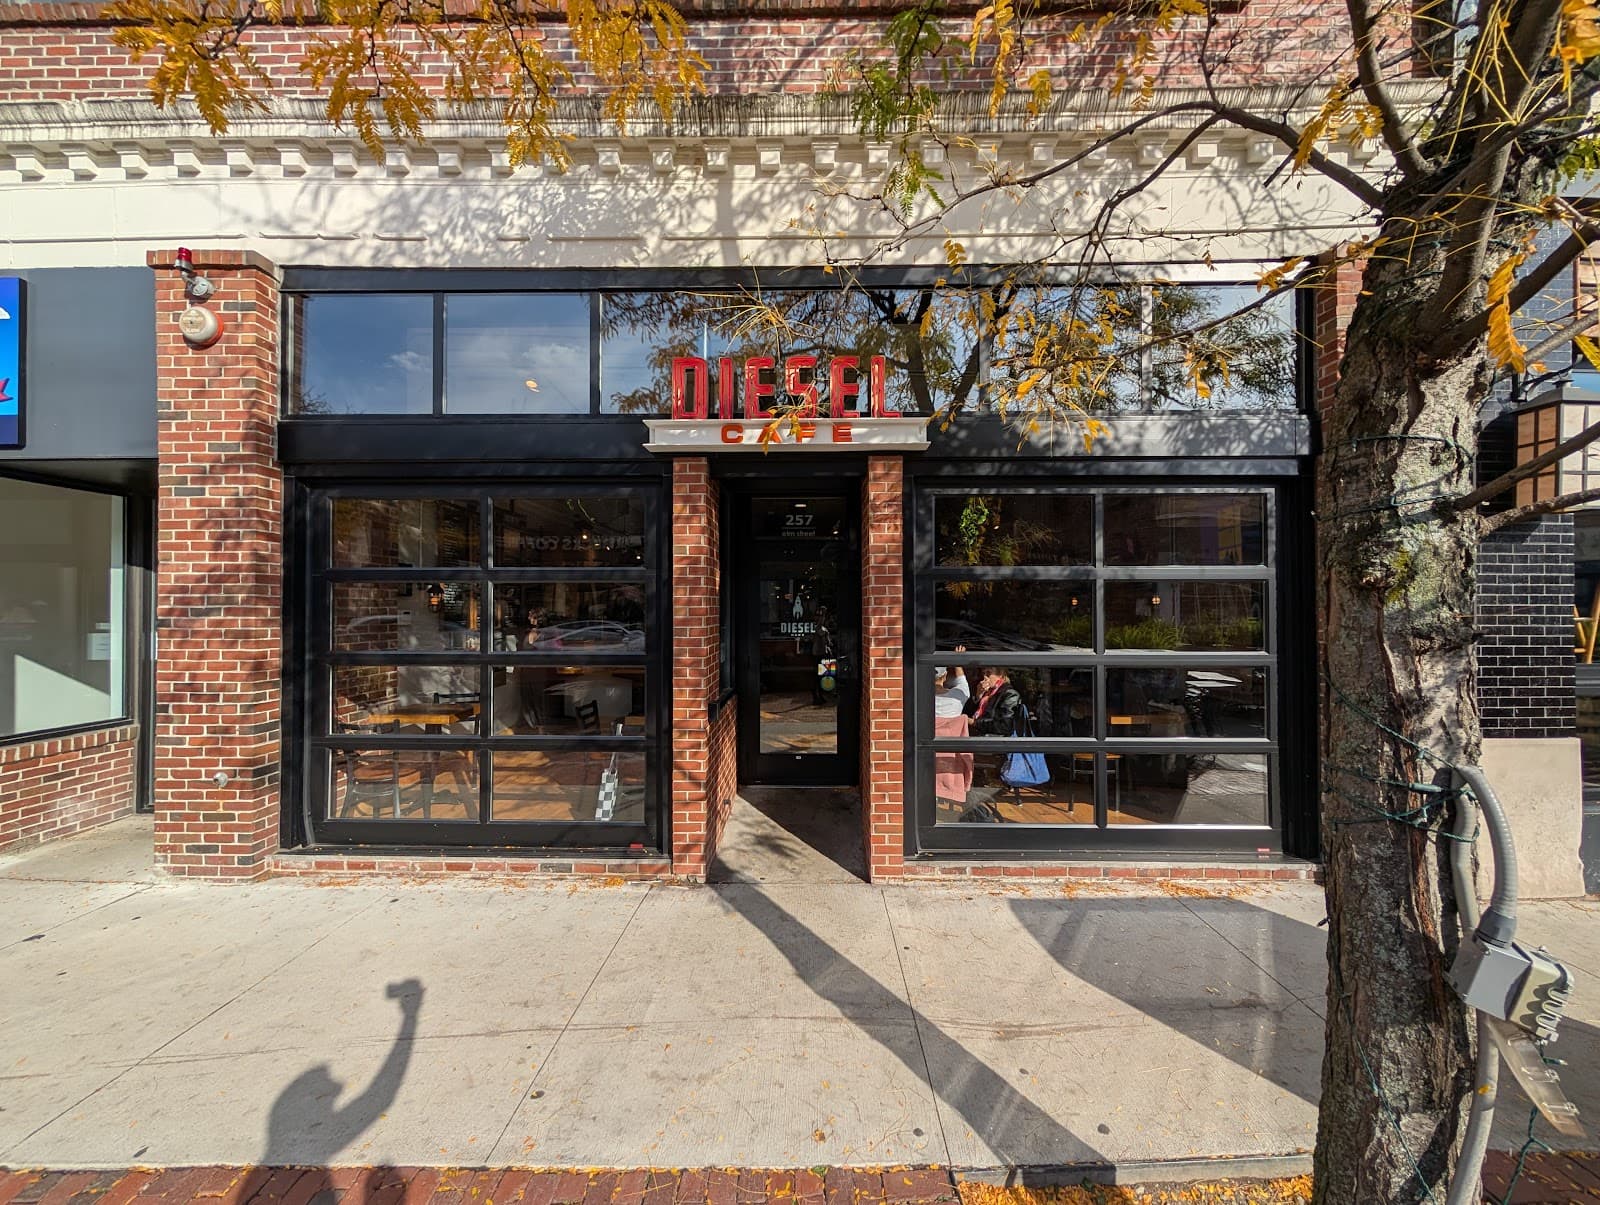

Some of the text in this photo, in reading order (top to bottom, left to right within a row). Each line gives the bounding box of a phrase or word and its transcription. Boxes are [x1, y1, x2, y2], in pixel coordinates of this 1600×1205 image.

[672, 355, 901, 419] DIESEL
[721, 422, 853, 443] CAFE
[785, 514, 814, 526] 257
[780, 622, 816, 633] DIESEL
